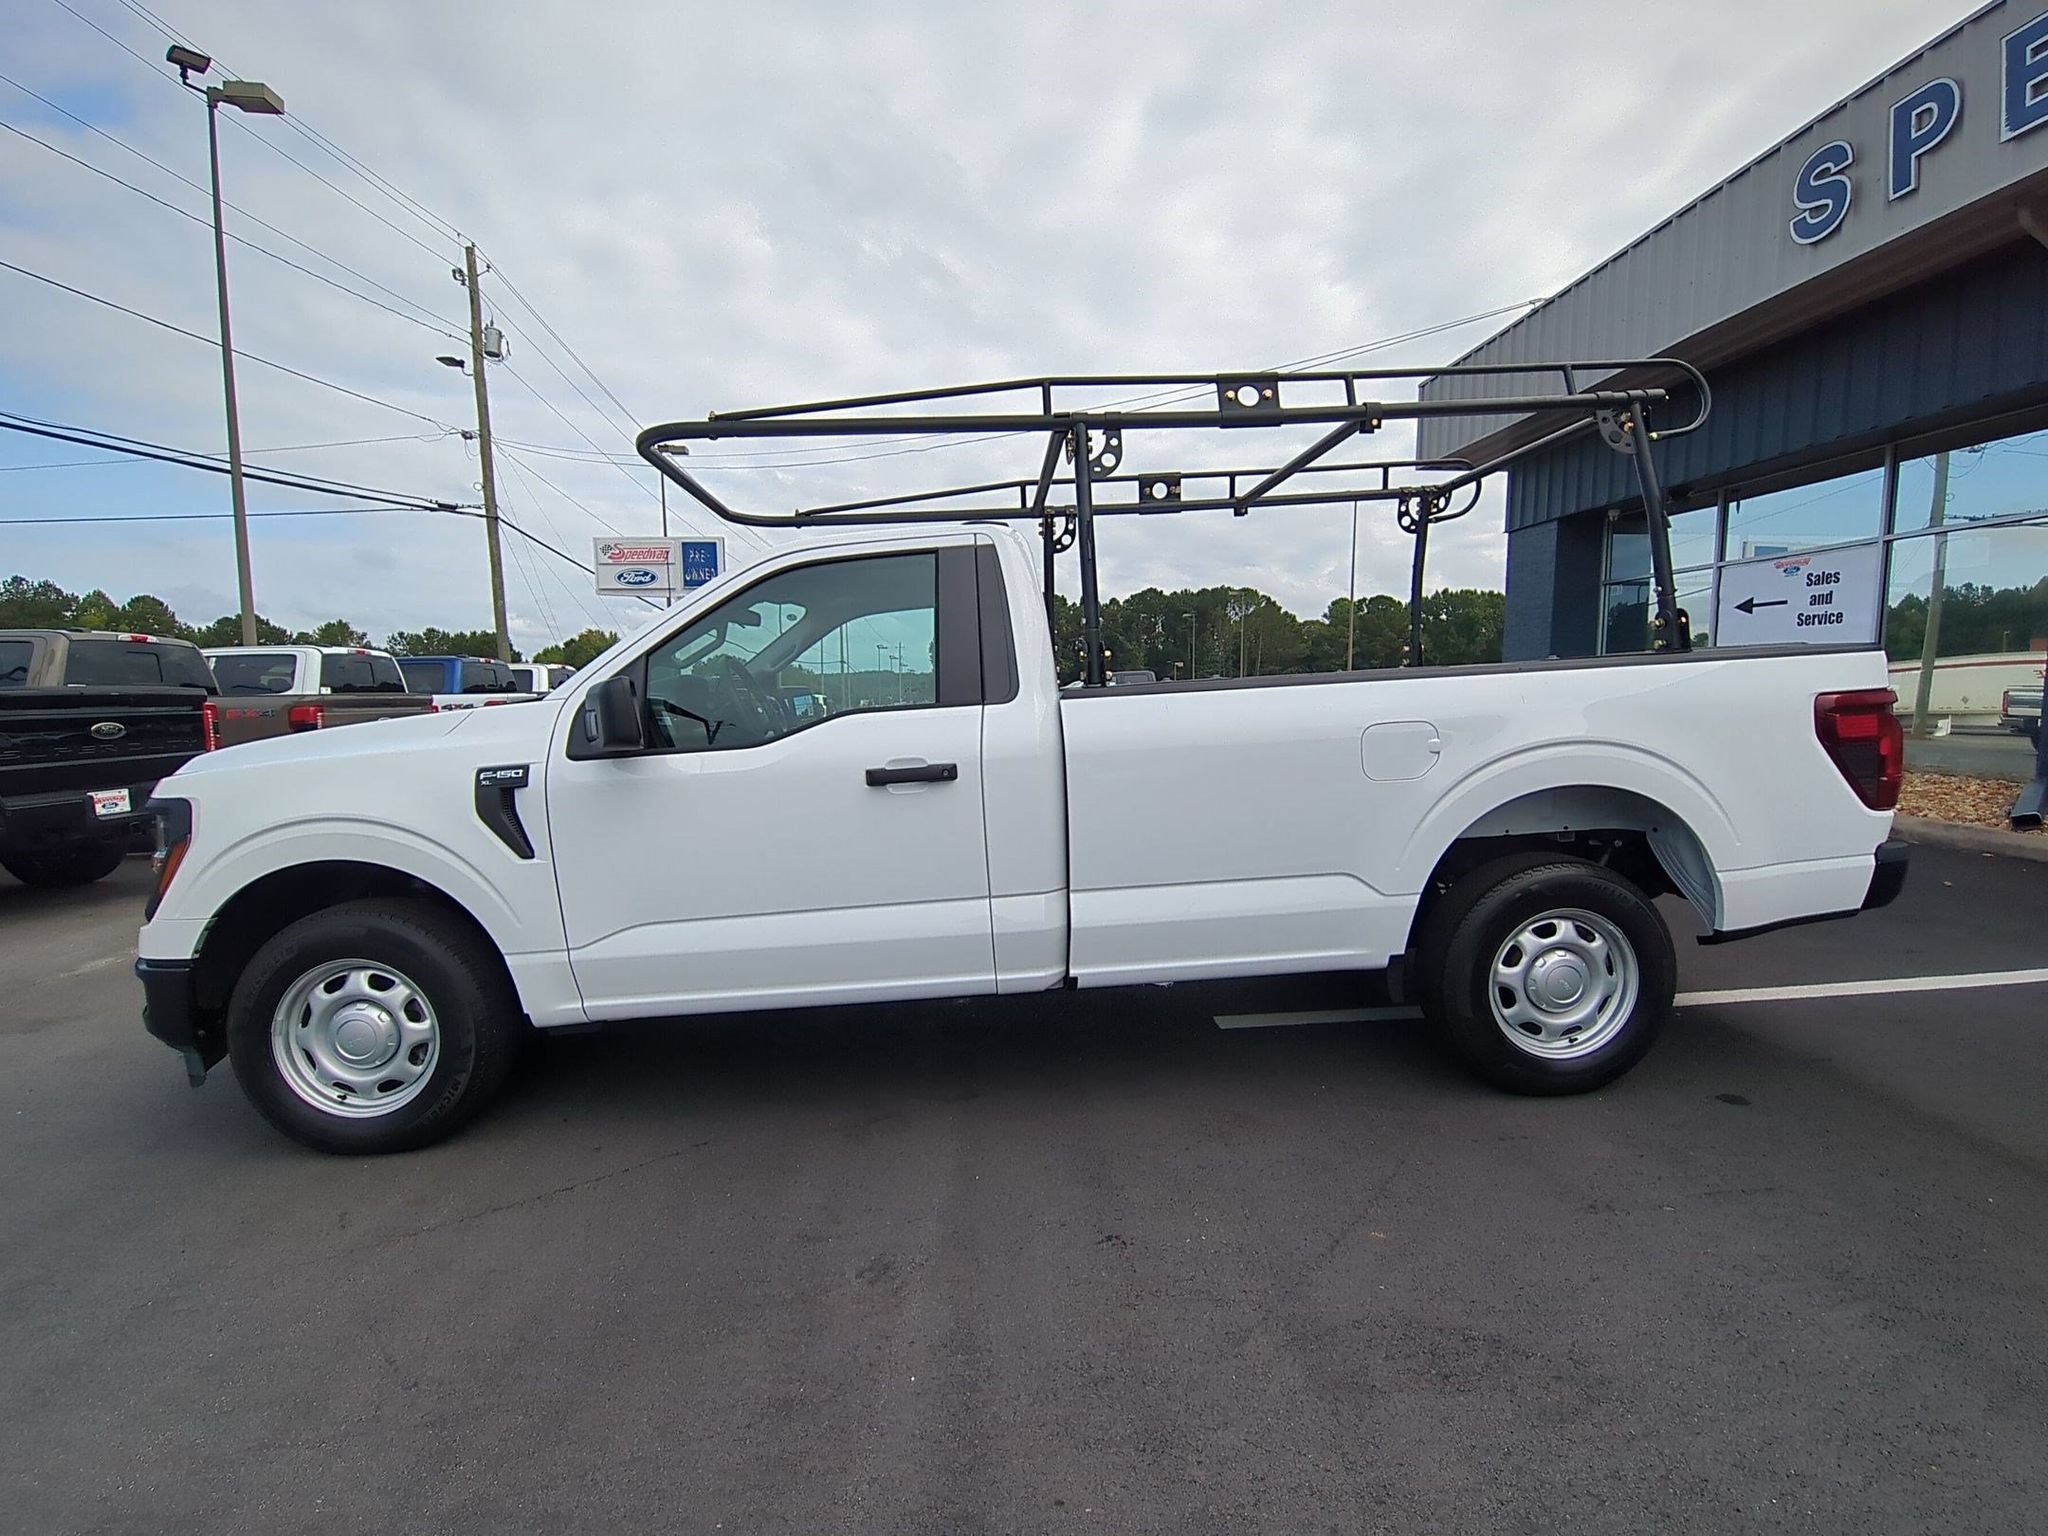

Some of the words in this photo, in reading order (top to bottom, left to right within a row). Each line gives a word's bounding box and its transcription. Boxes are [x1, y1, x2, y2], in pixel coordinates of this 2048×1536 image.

[1789, 10, 2048, 245] SPE
[608, 543, 671, 562] Speedway
[620, 571, 652, 583] Ford
[1806, 571, 1840, 587] Sales
[1809, 591, 1833, 606] and
[1797, 612, 1843, 627] Service
[480, 770, 523, 780] F-150
